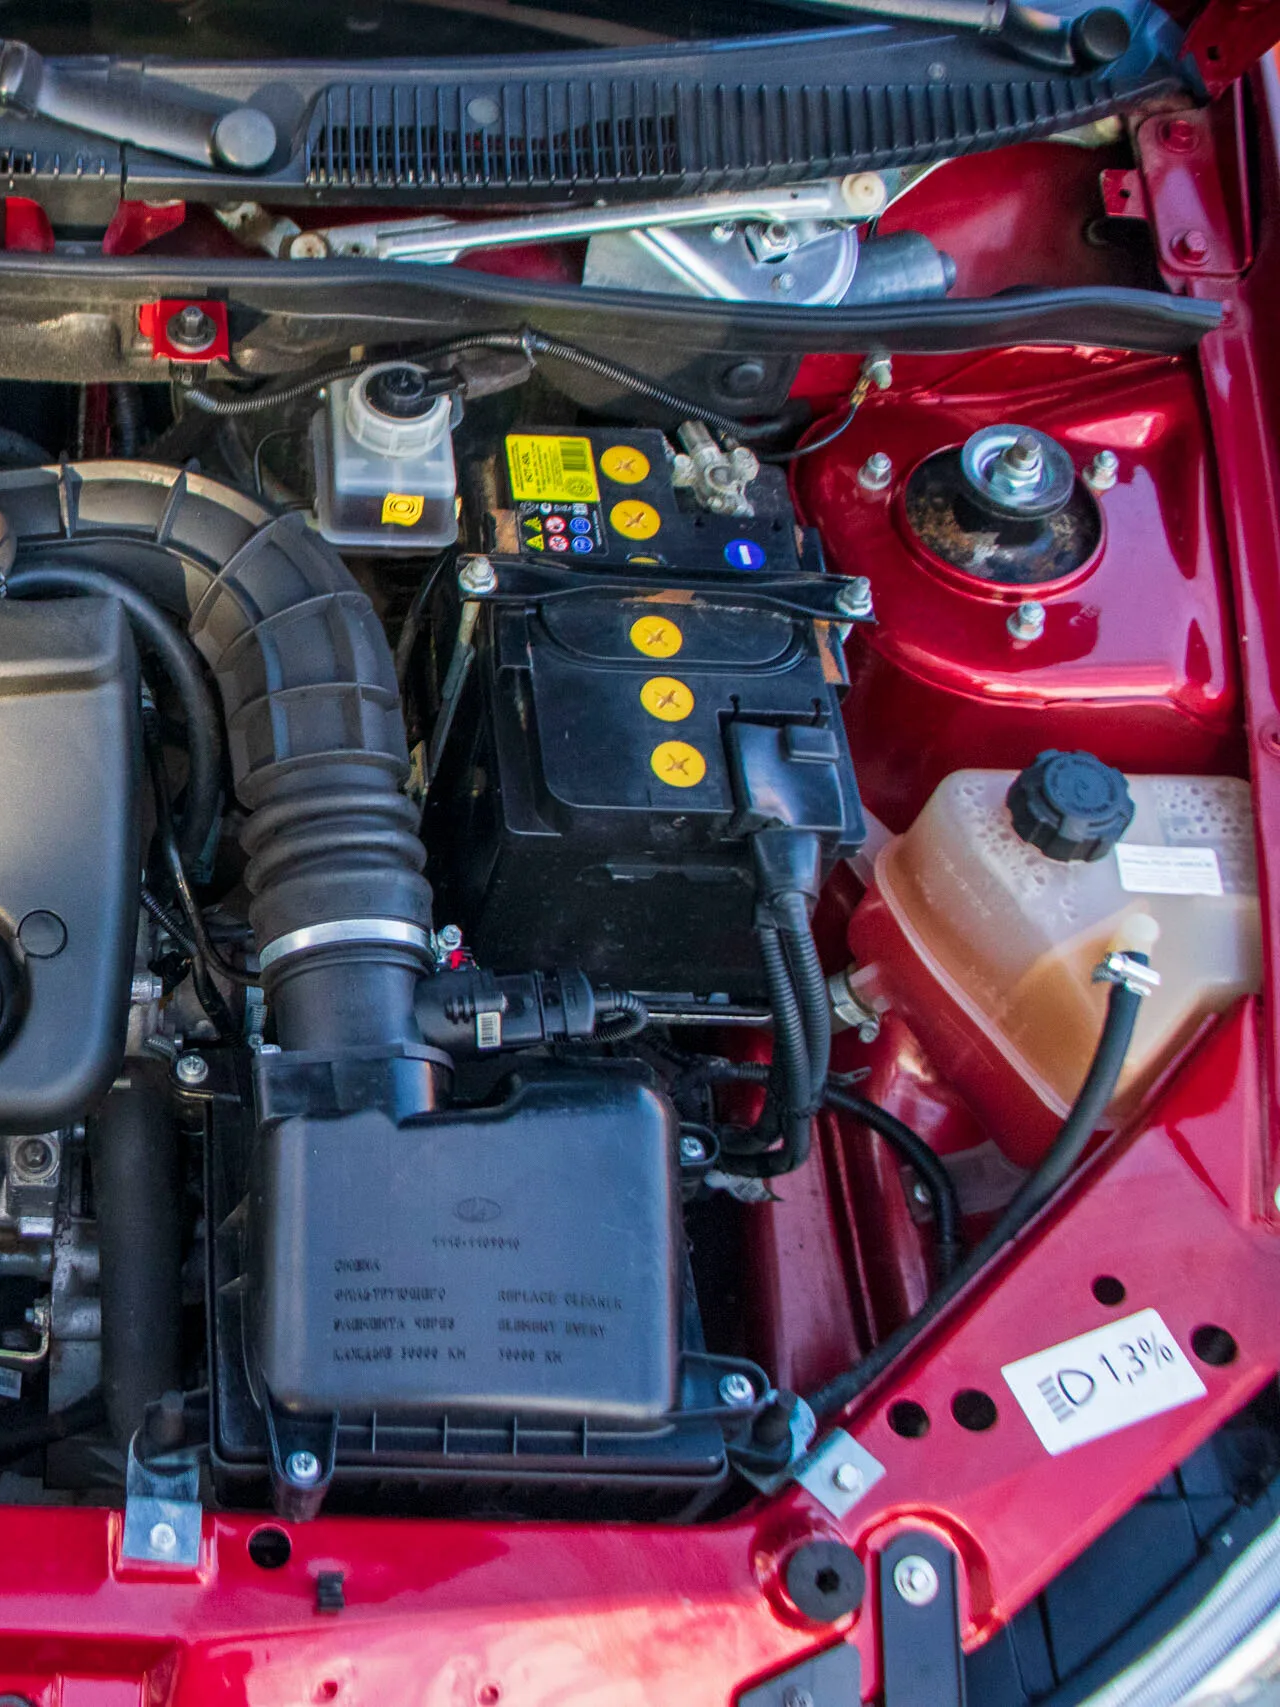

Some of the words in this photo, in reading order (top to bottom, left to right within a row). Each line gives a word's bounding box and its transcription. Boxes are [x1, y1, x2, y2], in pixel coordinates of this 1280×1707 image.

[497, 1289, 557, 1306] REPLACE
[497, 1319, 555, 1336] ELEMENT
[564, 1321, 605, 1339] EVERY
[1098, 1330, 1175, 1386] 1,3%
